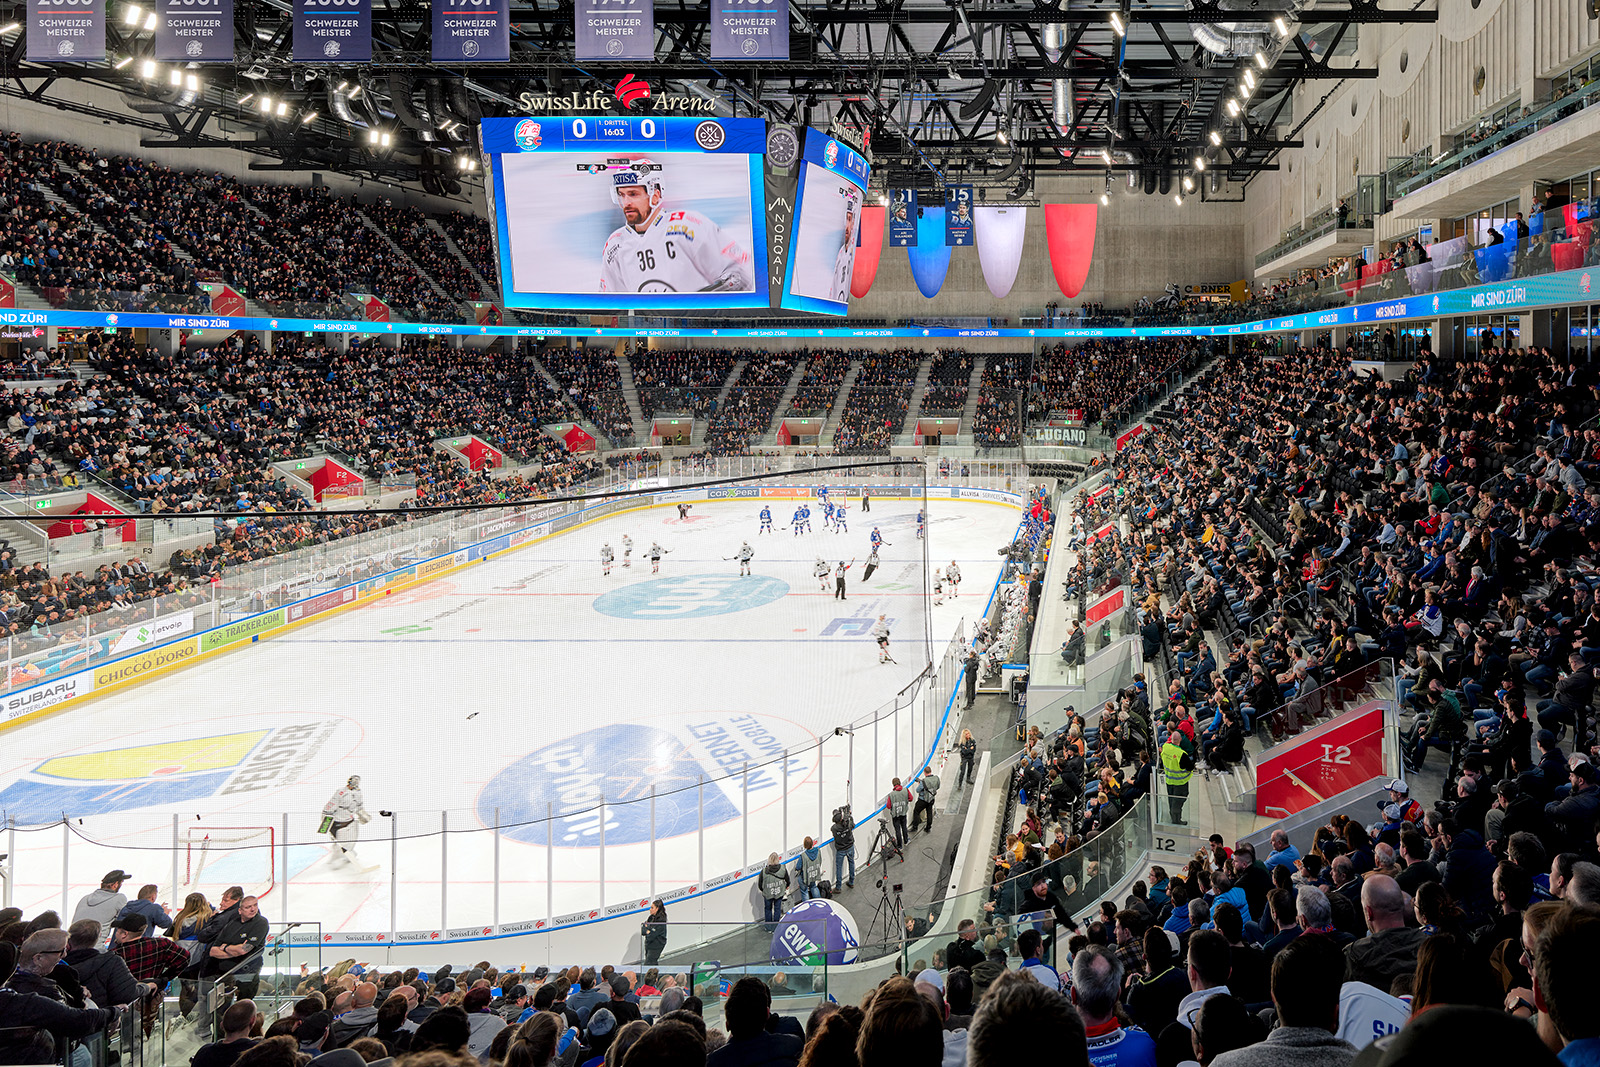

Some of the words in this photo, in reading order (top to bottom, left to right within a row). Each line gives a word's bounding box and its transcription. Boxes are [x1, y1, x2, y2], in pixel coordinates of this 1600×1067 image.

[588, 18, 641, 26] SCHWEIZER
[520, 90, 612, 110] SwissLife
[652, 92, 717, 111] Arena
[572, 119, 586, 138] 0
[641, 119, 655, 138] 0
[516, 136, 542, 146] ZSC
[666, 241, 676, 259] C
[772, 213, 785, 285] NORQAIN
[637, 249, 656, 272] 36
[1472, 293, 1485, 307] MIR
[1486, 290, 1505, 306] SIND
[1506, 285, 1526, 304] ZÜRI
[0, 314, 17, 323] ND
[21, 313, 47, 323] ZÜRI
[169, 318, 186, 326] MIR
[188, 319, 209, 327] SIND
[210, 318, 230, 328] ZÜRI
[1036, 428, 1086, 443] LUGANO
[425, 558, 453, 573] EICHHOF
[226, 613, 280, 638] TRACKER.COM
[99, 660, 152, 684] CHICCO
[156, 646, 194, 666] D'ORO
[9, 680, 76, 710] SUBARU
[9, 696, 62, 719] SWITZERLAND'S
[220, 722, 321, 796] FENSTER
[686, 721, 778, 793] INTERNET
[1321, 744, 1351, 765] I2
[1156, 838, 1175, 852] I2
[706, 876, 732, 888] SwissLife
[608, 902, 637, 915] SwissLife
[502, 923, 532, 933] SwissLife
[556, 914, 586, 925] SwissLife
[450, 930, 479, 938] SwissLife
[1088, 1034, 1120, 1047] TADLER
